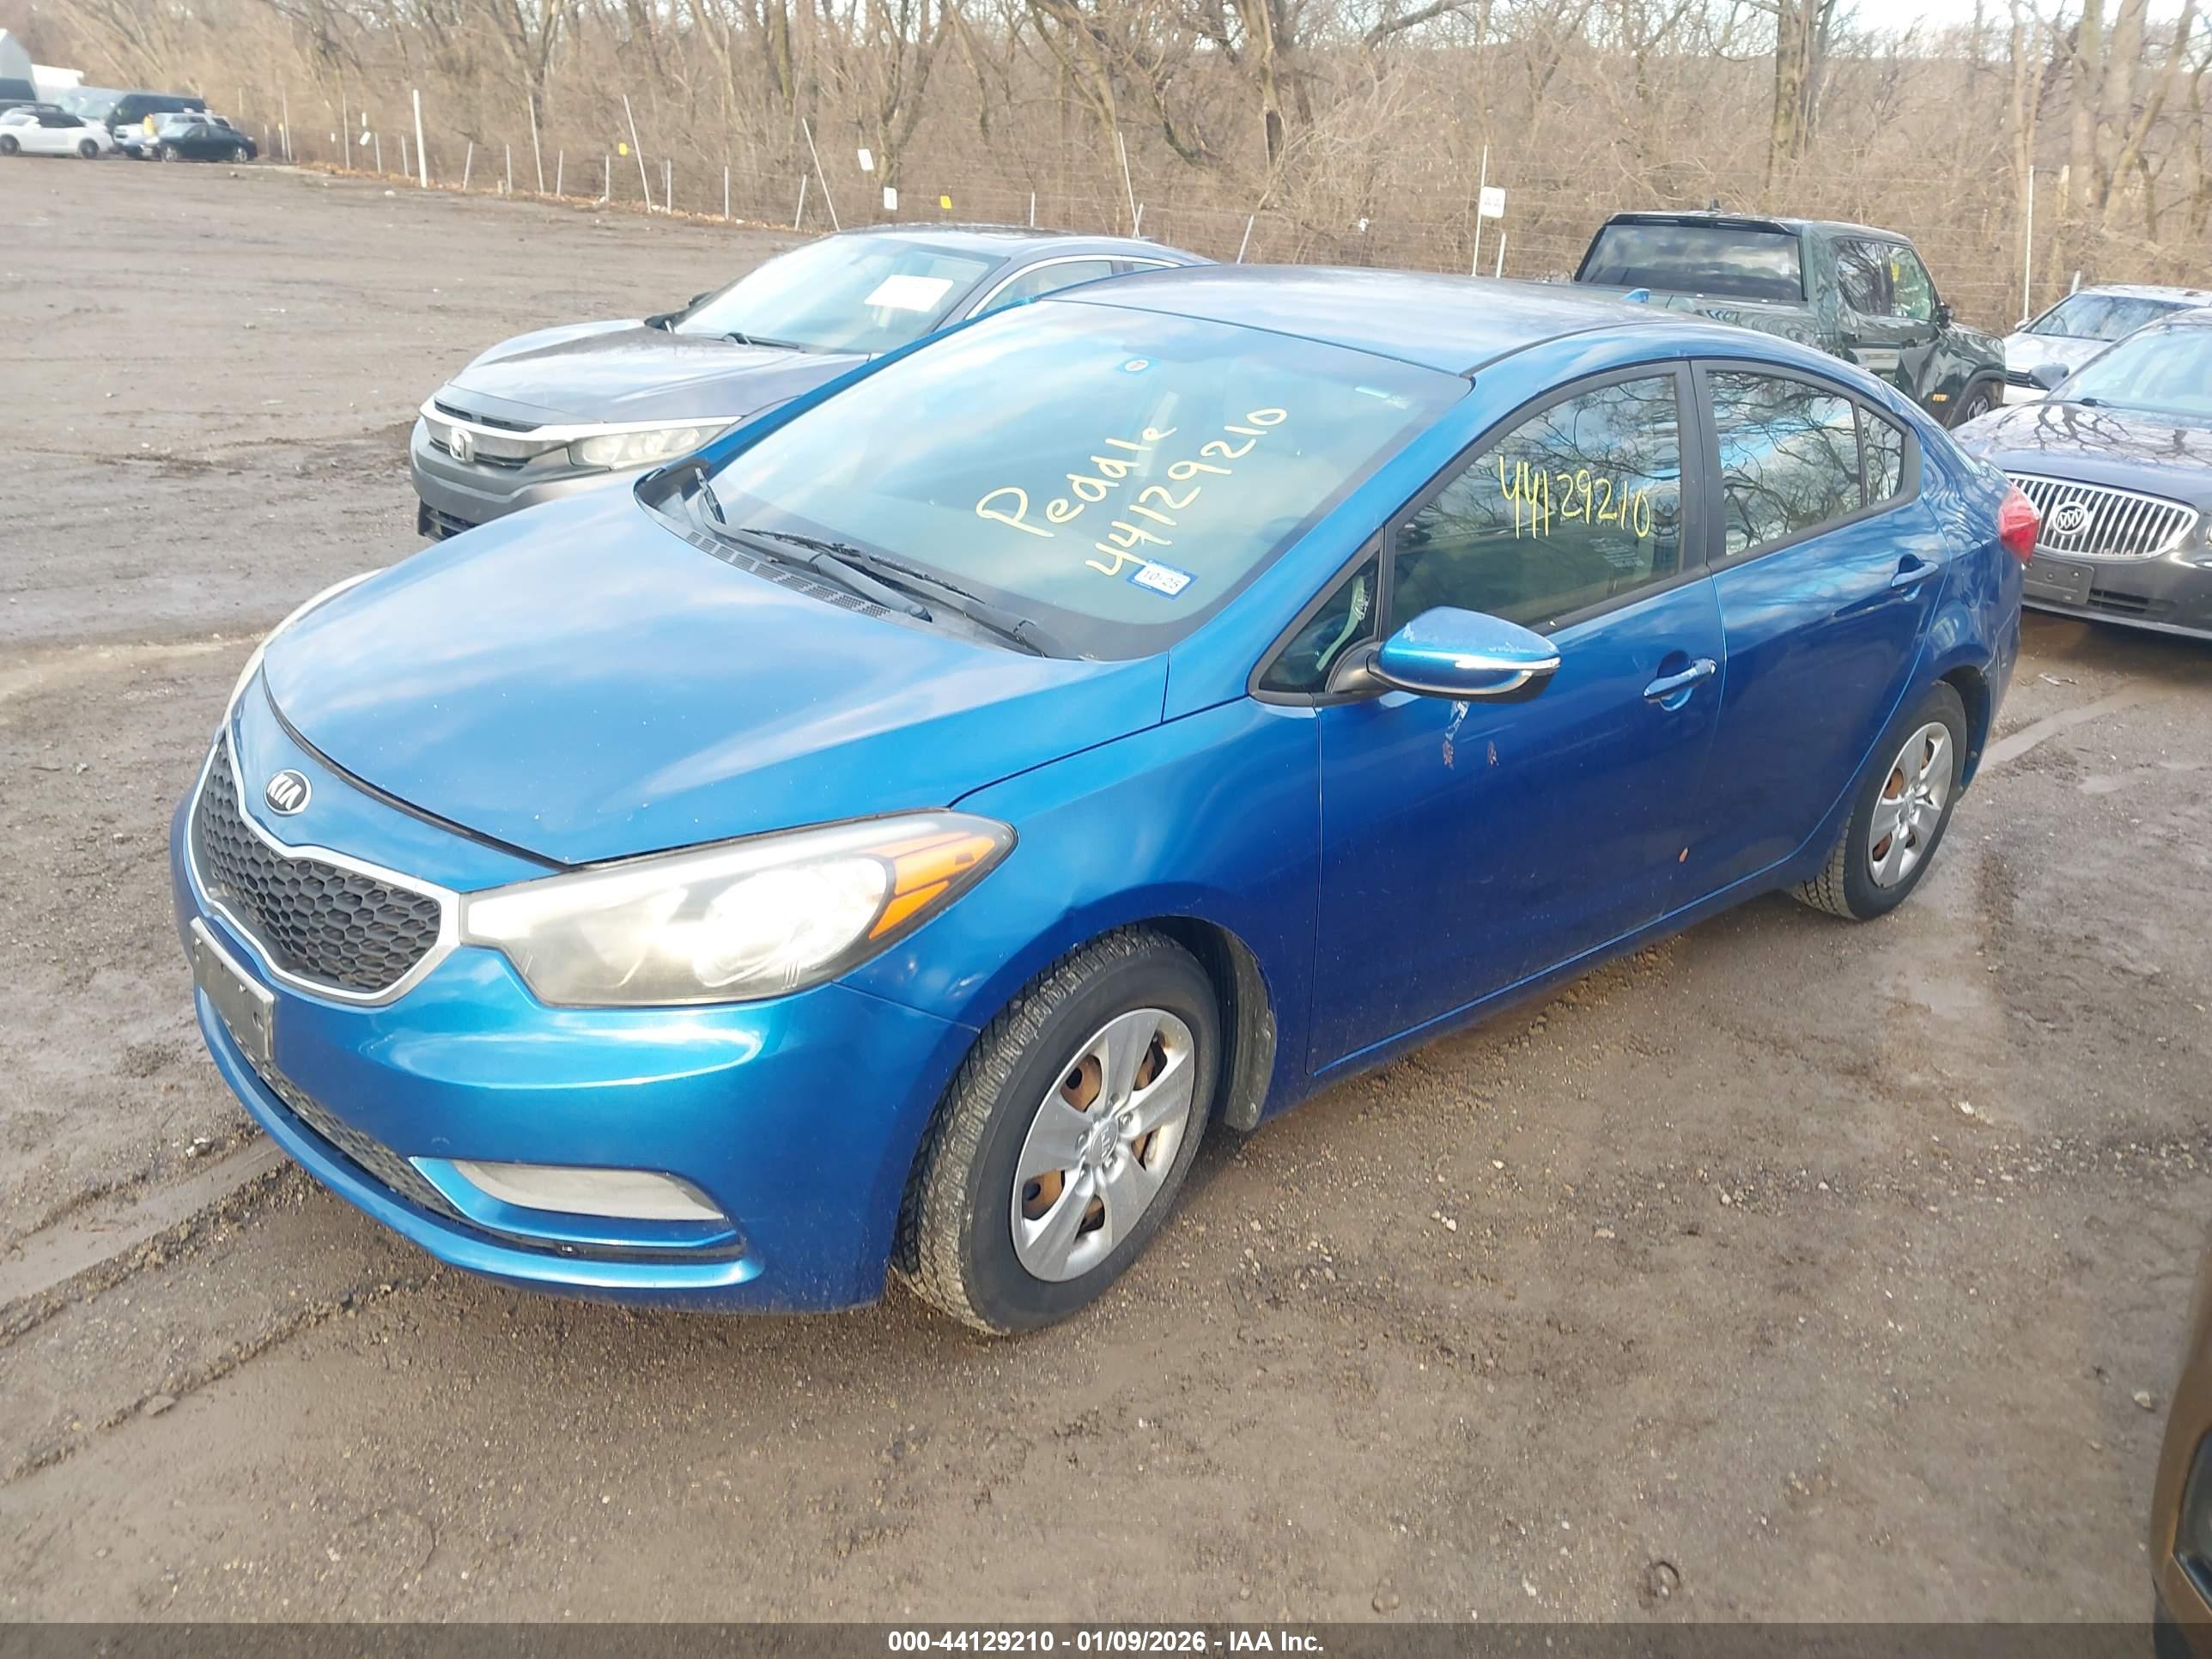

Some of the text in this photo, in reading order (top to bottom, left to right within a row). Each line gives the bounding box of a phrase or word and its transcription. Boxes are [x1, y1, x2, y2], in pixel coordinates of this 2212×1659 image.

[975, 426, 1176, 538] Peddle
[1085, 407, 1287, 576] 44129210
[1499, 455, 1650, 540] 44129210
